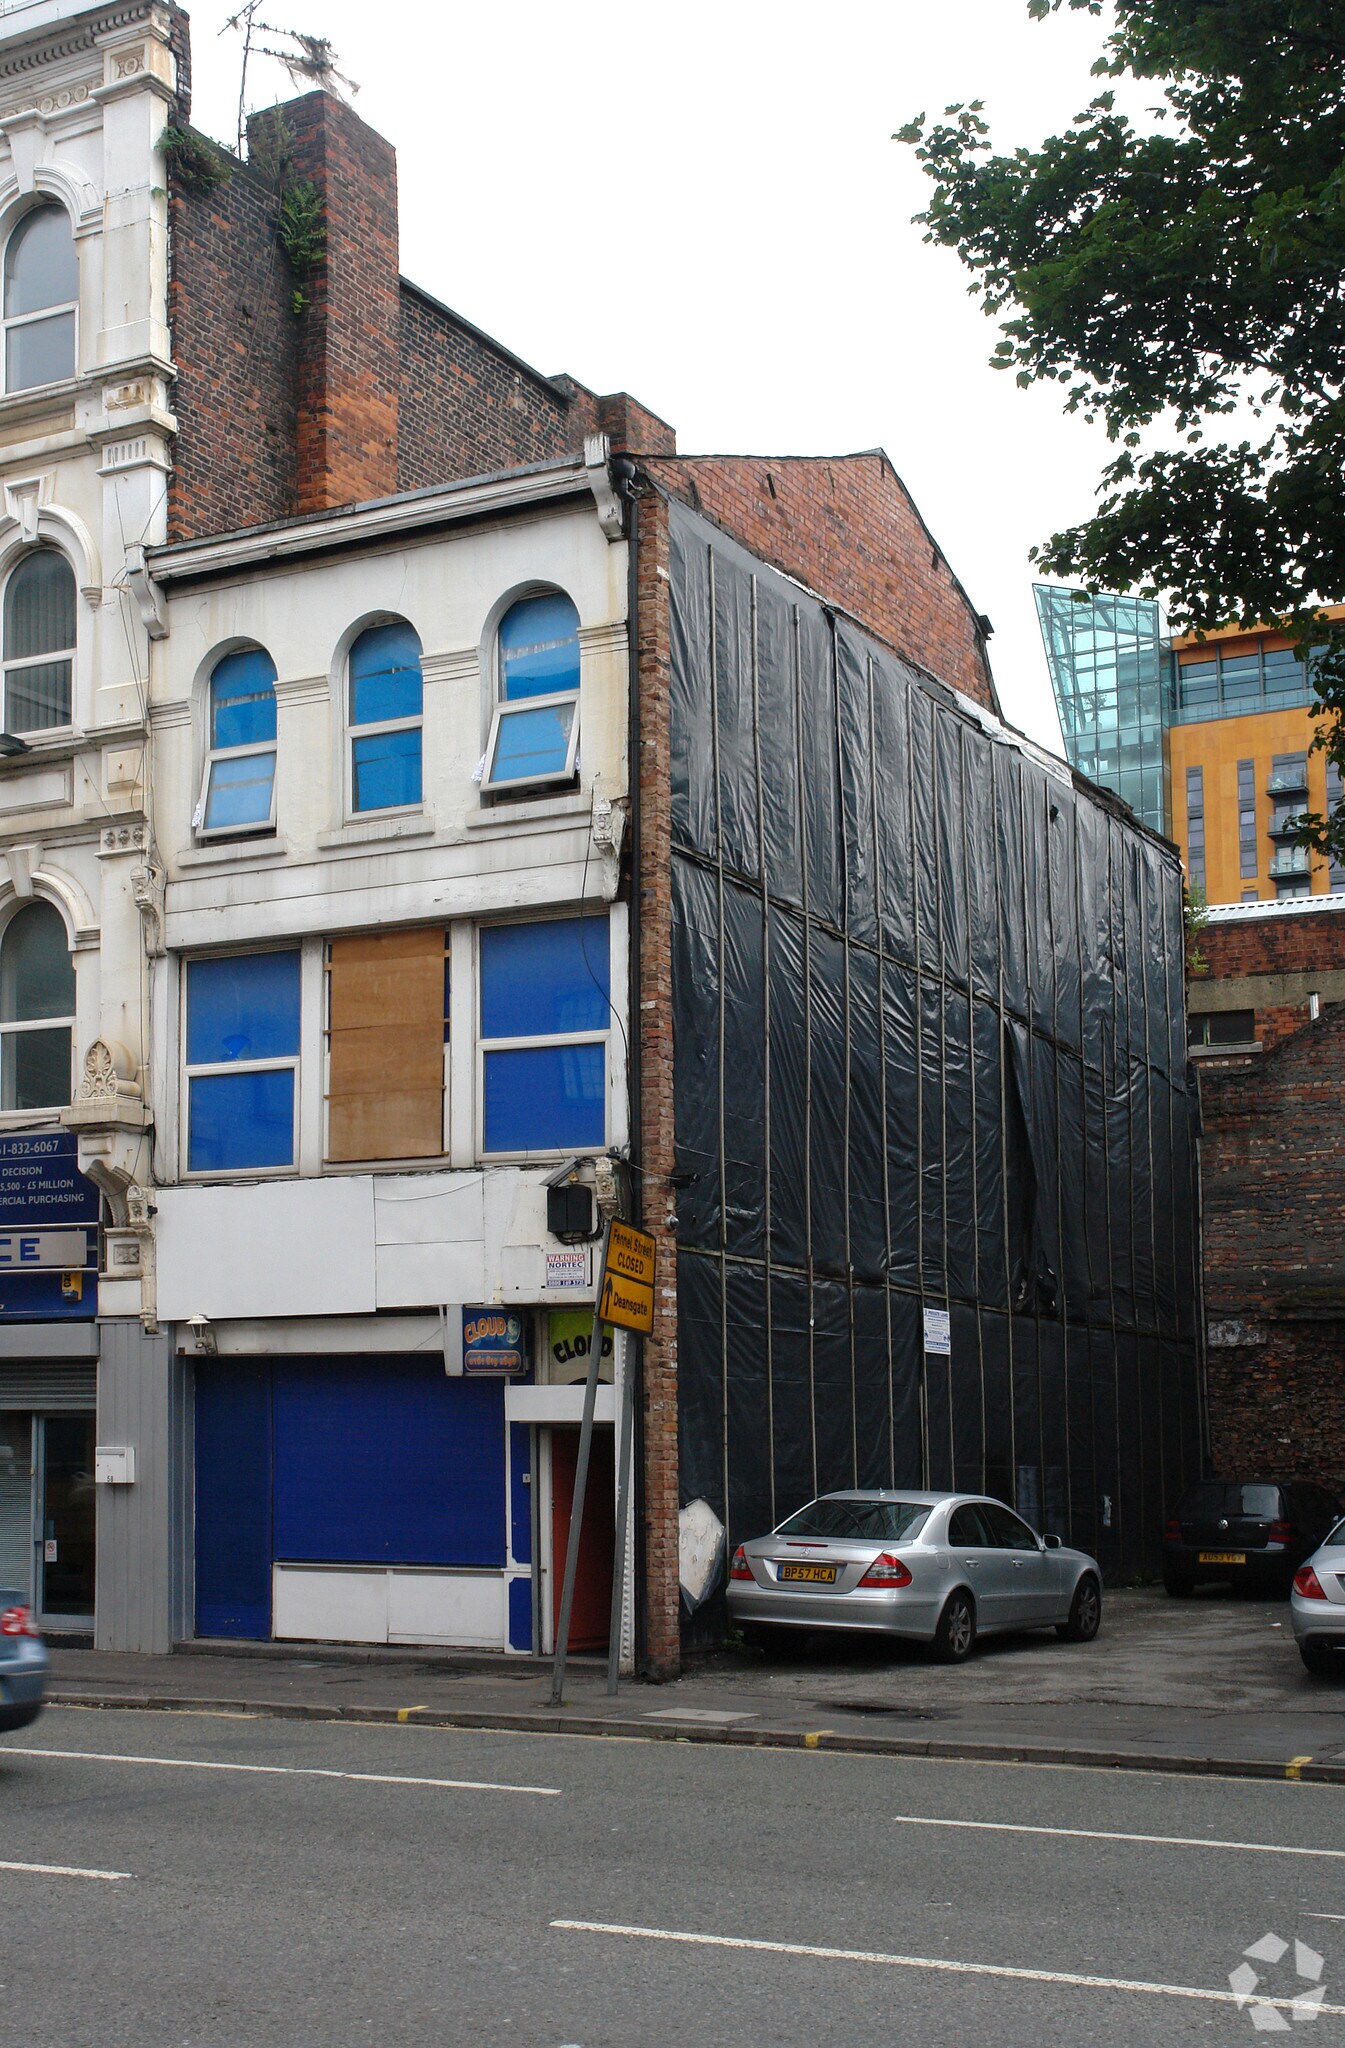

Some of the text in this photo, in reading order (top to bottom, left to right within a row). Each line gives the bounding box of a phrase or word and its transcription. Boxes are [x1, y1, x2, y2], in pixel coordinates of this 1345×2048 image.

[2, 1167, 43, 1176] DECISION
[27, 1181, 37, 1190] £5
[38, 1180, 74, 1189] MILLION
[28, 1193, 85, 1204] PURCHASING
[613, 1228, 652, 1258] Fennel Street
[548, 1254, 584, 1262] WARNING
[617, 1252, 644, 1274] CLOSED
[613, 1291, 648, 1316] Deansgate
[464, 1317, 506, 1344] CLOUD
[784, 1567, 833, 1581] BP57 HCA
